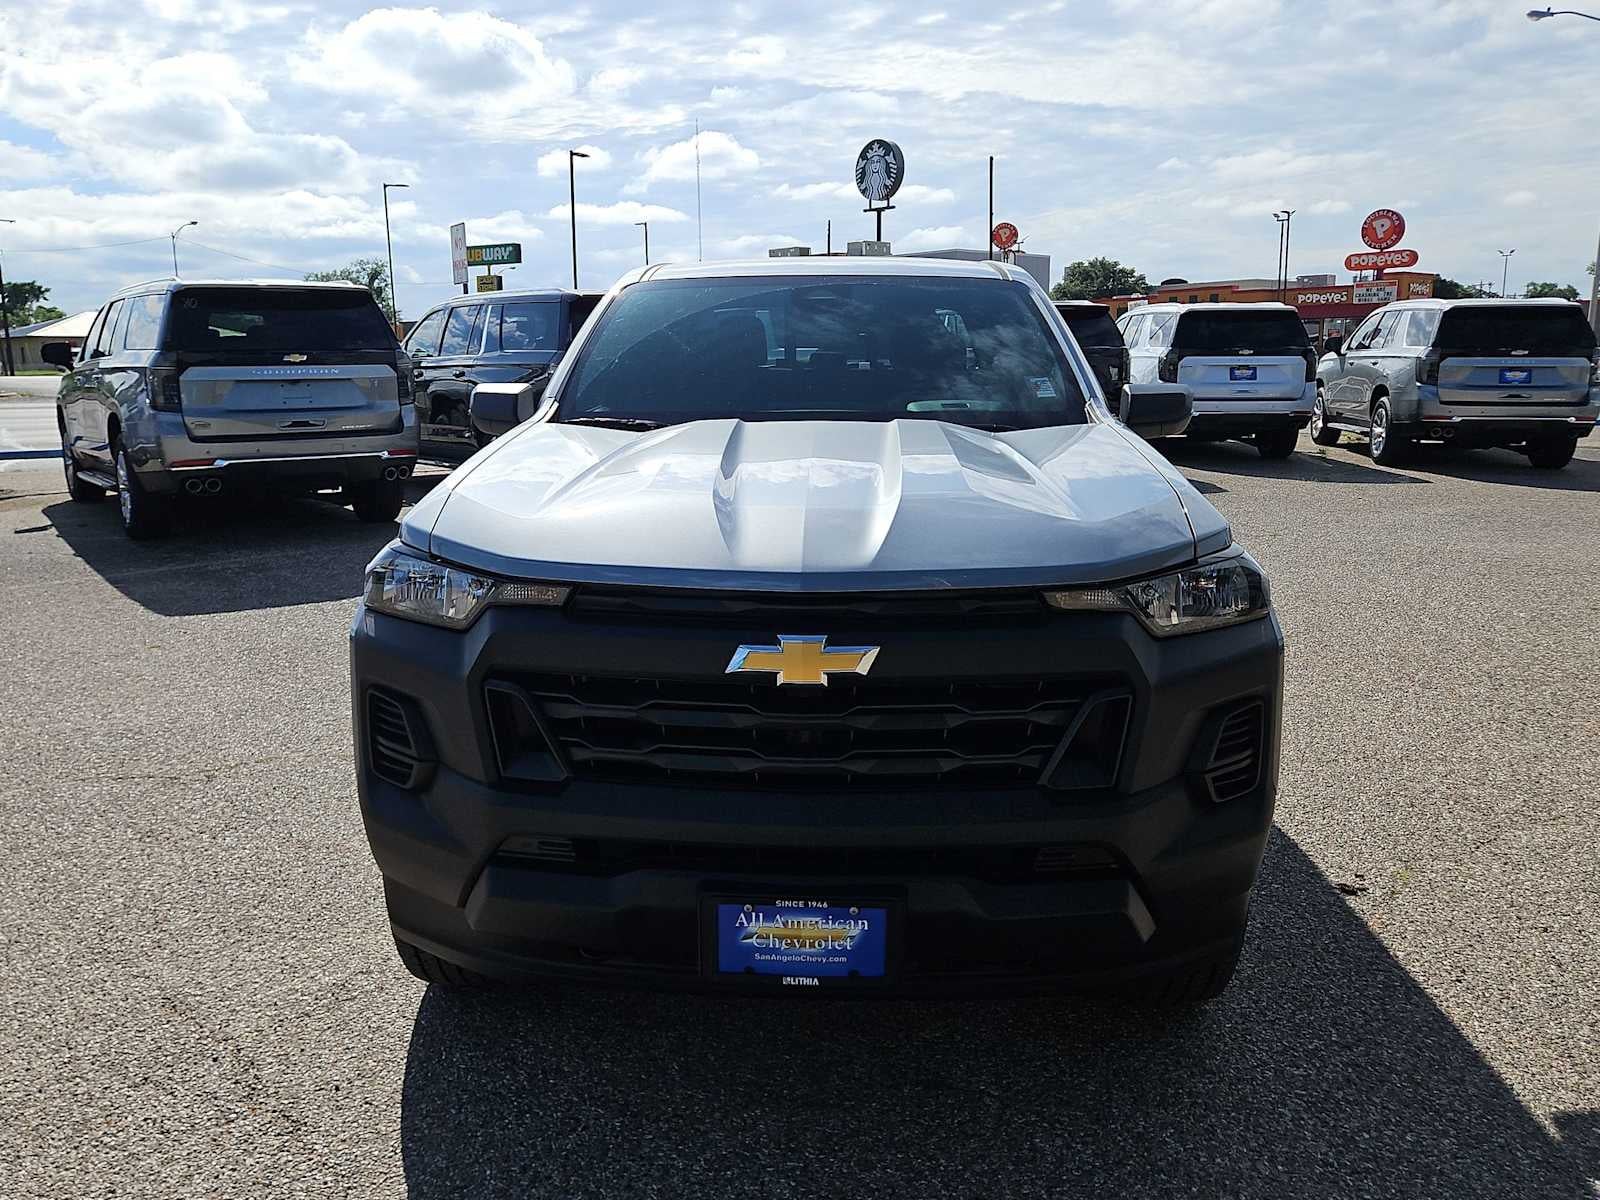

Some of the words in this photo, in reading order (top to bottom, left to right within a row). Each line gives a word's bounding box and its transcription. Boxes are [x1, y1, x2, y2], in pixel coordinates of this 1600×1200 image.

[1372, 218, 1391, 239] P
[1363, 233, 1398, 249] KITCHEN
[467, 247, 509, 261] UBWAY
[775, 899, 805, 908] SINCE
[808, 900, 828, 909] 1946
[735, 911, 764, 928] All
[772, 912, 869, 931] American
[751, 933, 854, 951] Chevrolet
[754, 952, 848, 964] SanAngeloChevy.com
[790, 977, 820, 986] LITHIA
